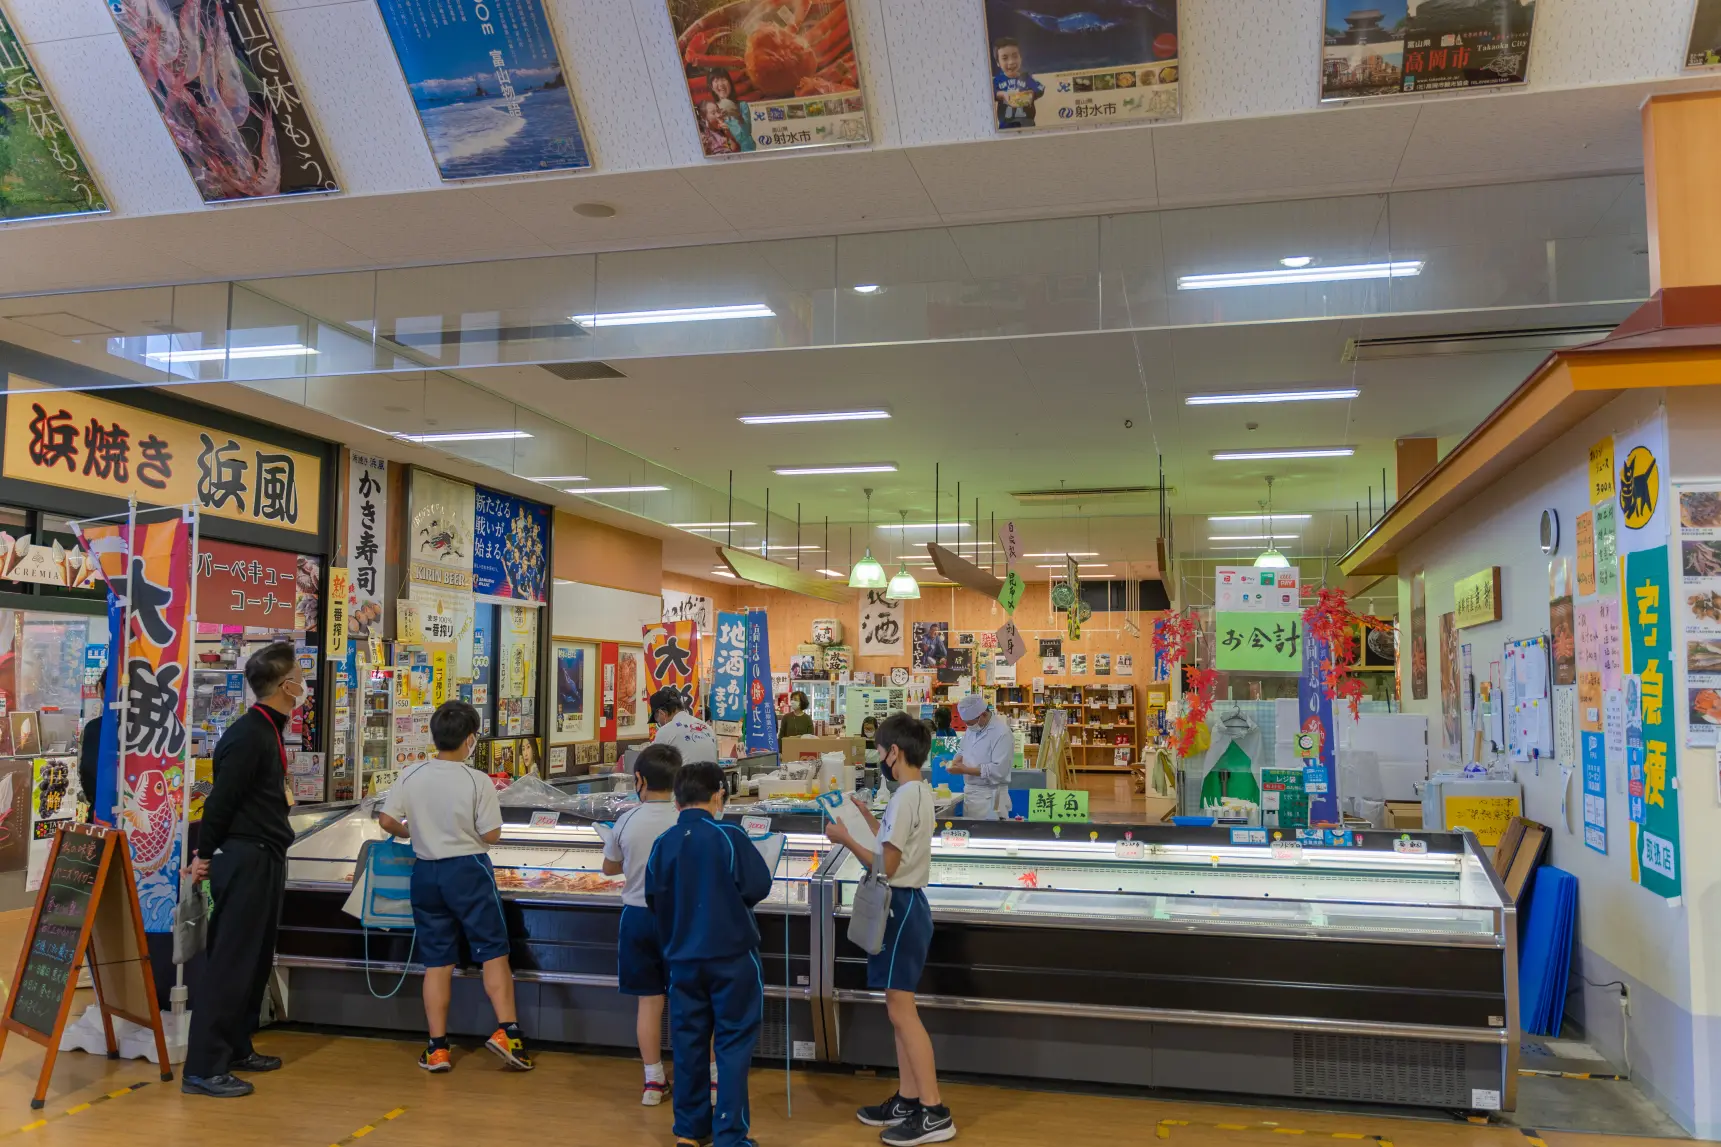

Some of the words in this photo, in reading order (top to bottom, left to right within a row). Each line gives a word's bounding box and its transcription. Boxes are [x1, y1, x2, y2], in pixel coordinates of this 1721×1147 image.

[1477, 43, 1509, 52] Takaoka
[1511, 40, 1528, 48] City
[1405, 47, 1471, 73] 高岡市
[0, 17, 107, 211] 山で休もう。
[1075, 103, 1117, 118] 射水市
[773, 130, 811, 144] 射水市
[28, 402, 173, 490] 浜焼き
[196, 432, 298, 525] 浜風
[475, 492, 511, 518] 新たなる
[355, 470, 381, 597] かき寿司
[475, 517, 504, 538] 戦いが
[474, 538, 501, 560] 始まる
[14, 567, 60, 580] CREMIA
[197, 553, 294, 584] バーベキュー
[415, 566, 442, 582] KIRIN
[444, 570, 466, 586] BEER
[231, 590, 293, 615] コーナー
[333, 600, 343, 651] 一番搾り
[425, 623, 453, 637] 一番搾り
[717, 620, 745, 677] 地酒
[914, 622, 925, 669] だいてやる
[1007, 623, 1015, 655] 刺身
[1222, 620, 1301, 658] お会計
[1276, 775, 1296, 784] レジ袋
[1034, 792, 1080, 819] 鮮魚
[1645, 838, 1672, 872] 取扱店
